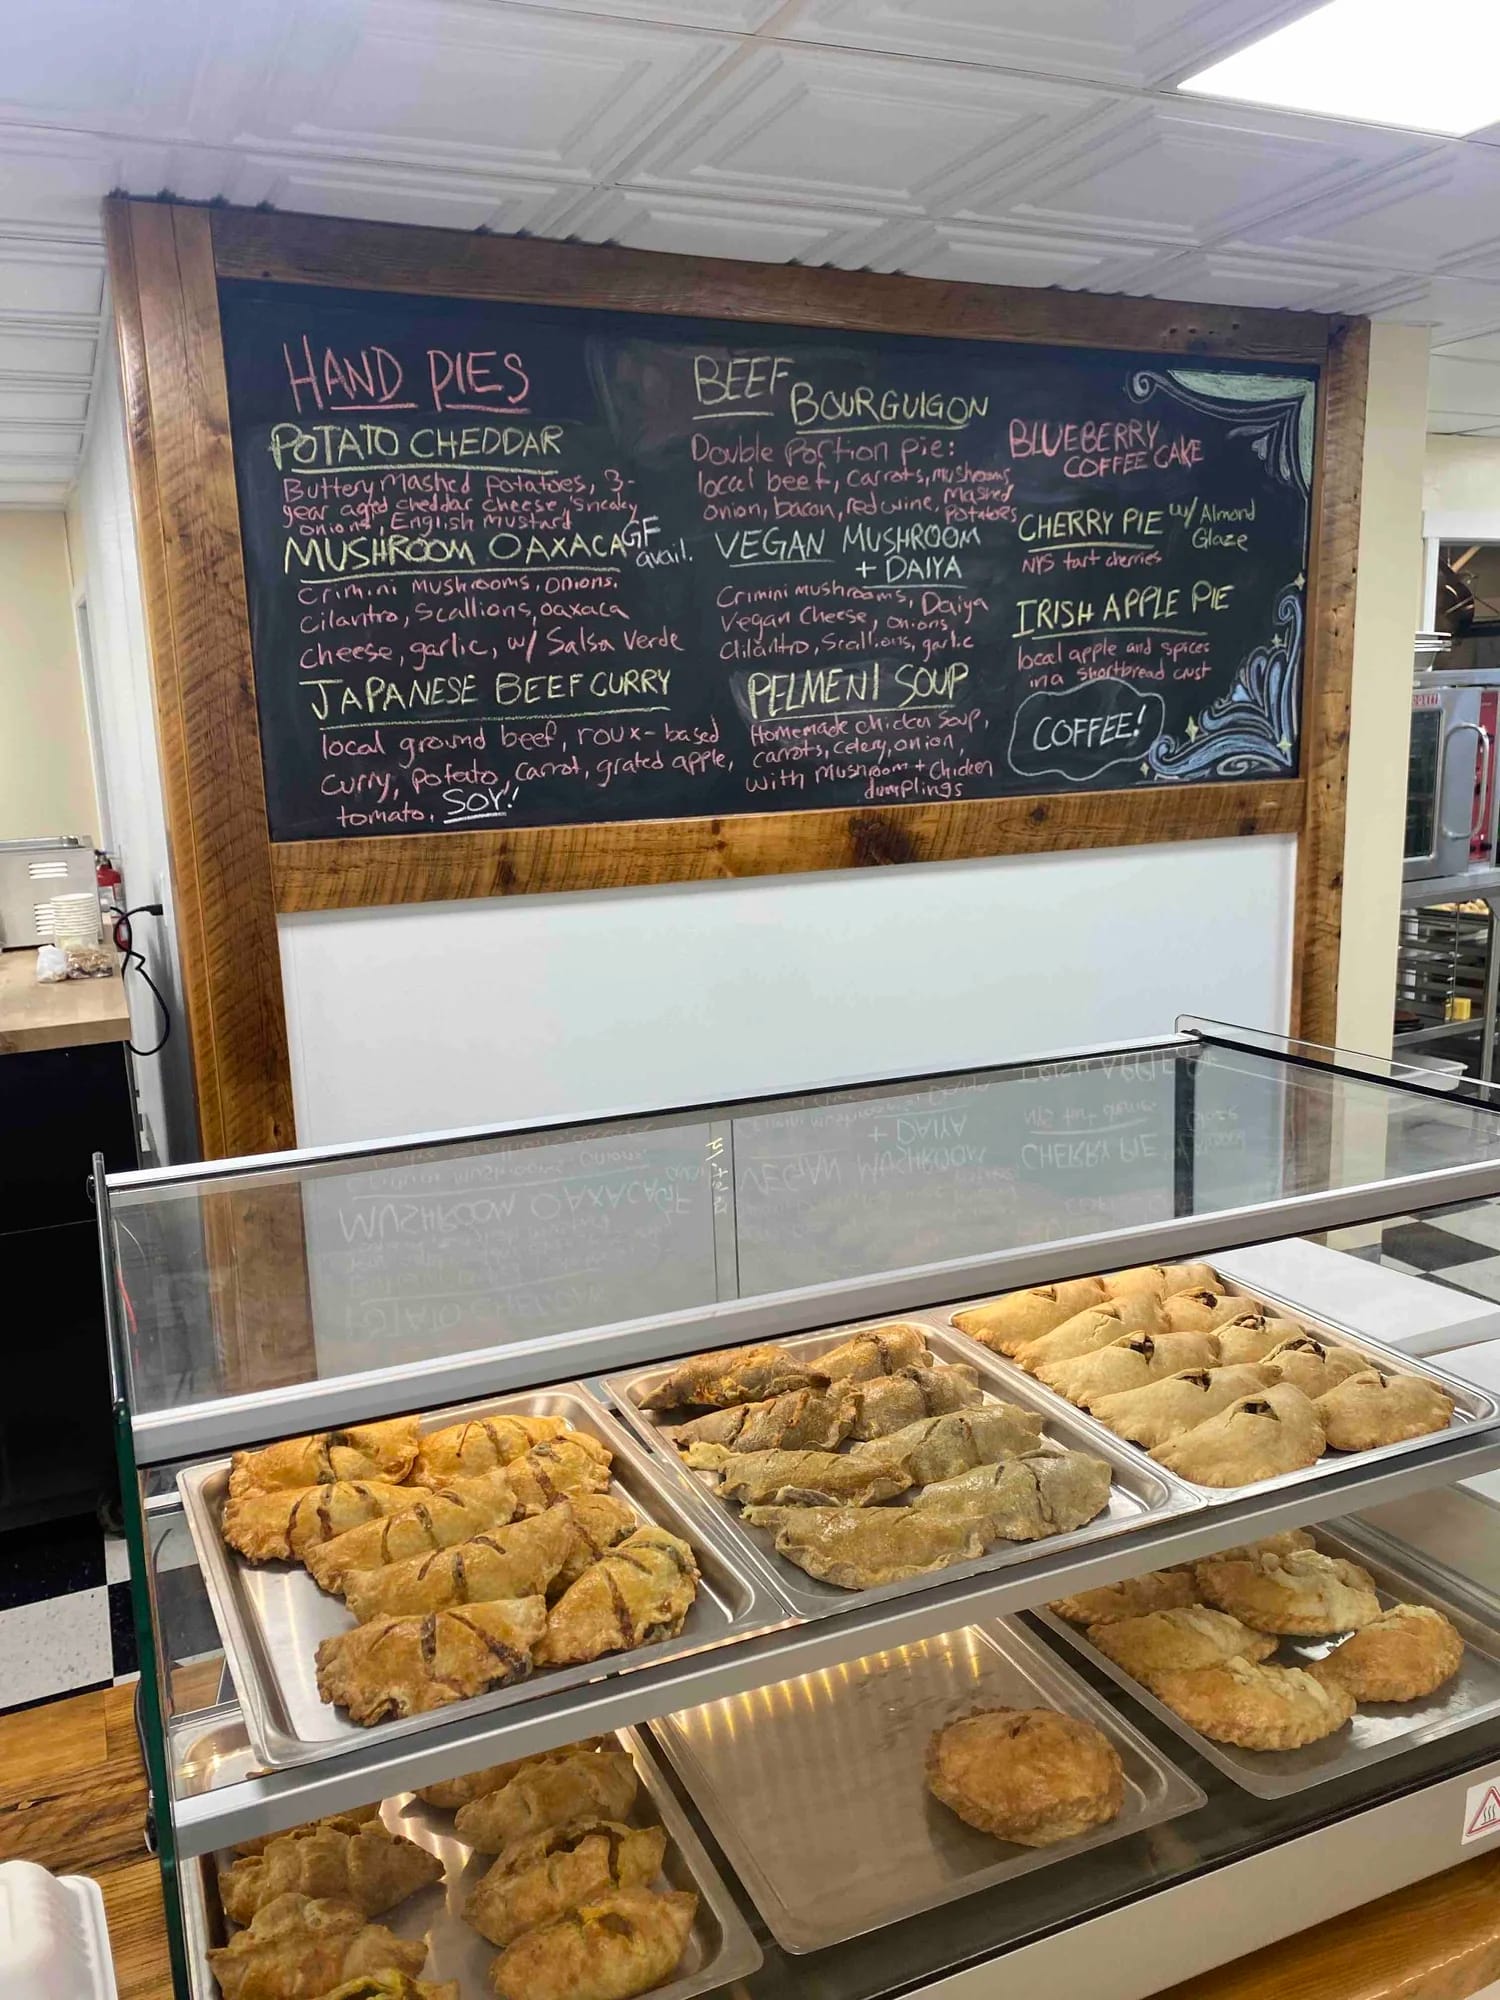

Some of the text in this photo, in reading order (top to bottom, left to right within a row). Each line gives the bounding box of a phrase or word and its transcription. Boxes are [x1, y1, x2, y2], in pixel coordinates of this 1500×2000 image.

[284, 334, 532, 412] HAND PIES
[693, 355, 989, 426] BEEF BOURGUIGON
[269, 423, 564, 470] POTATO CHEDDAR
[691, 431, 774, 465] Double
[1009, 418, 1160, 459] BLUEBERRY
[1063, 435, 1204, 478] COFFEE CAKE
[284, 476, 374, 503] Buttery
[698, 466, 754, 498] local
[283, 505, 330, 528] year
[396, 493, 473, 513] cheddar
[391, 512, 474, 537] English
[1018, 496, 1256, 542] CHERRY PIE w/ Almond
[621, 515, 661, 549] GF
[715, 522, 982, 560] VEGAN MUSHROOM
[1192, 527, 1249, 552] Glaze
[284, 532, 627, 574] MUSHROOM OAXACA
[855, 555, 963, 583] + DAIYA
[1063, 548, 1101, 571] tart
[1105, 550, 1162, 569] cherries
[922, 591, 989, 624] Daiya
[1012, 580, 1235, 638] IRISH APPLE PIE
[507, 630, 537, 663] w/
[546, 626, 615, 656] Salsa
[623, 625, 685, 651] Verde
[1017, 641, 1062, 672] local
[1069, 637, 1118, 663] apple
[1126, 637, 1152, 655] and
[1077, 658, 1165, 681] shortbread
[299, 668, 671, 720] JAPANESE BEEF CURRY
[747, 662, 969, 719] PELMENI SOUP
[322, 730, 385, 760] local
[399, 726, 486, 769] ground
[500, 720, 567, 752] beef,
[1032, 703, 1147, 752] COFFEE!
[596, 750, 665, 787] grated
[671, 748, 735, 775] apple,
[442, 786, 519, 816] SOY!
[864, 776, 963, 799] dumplings
